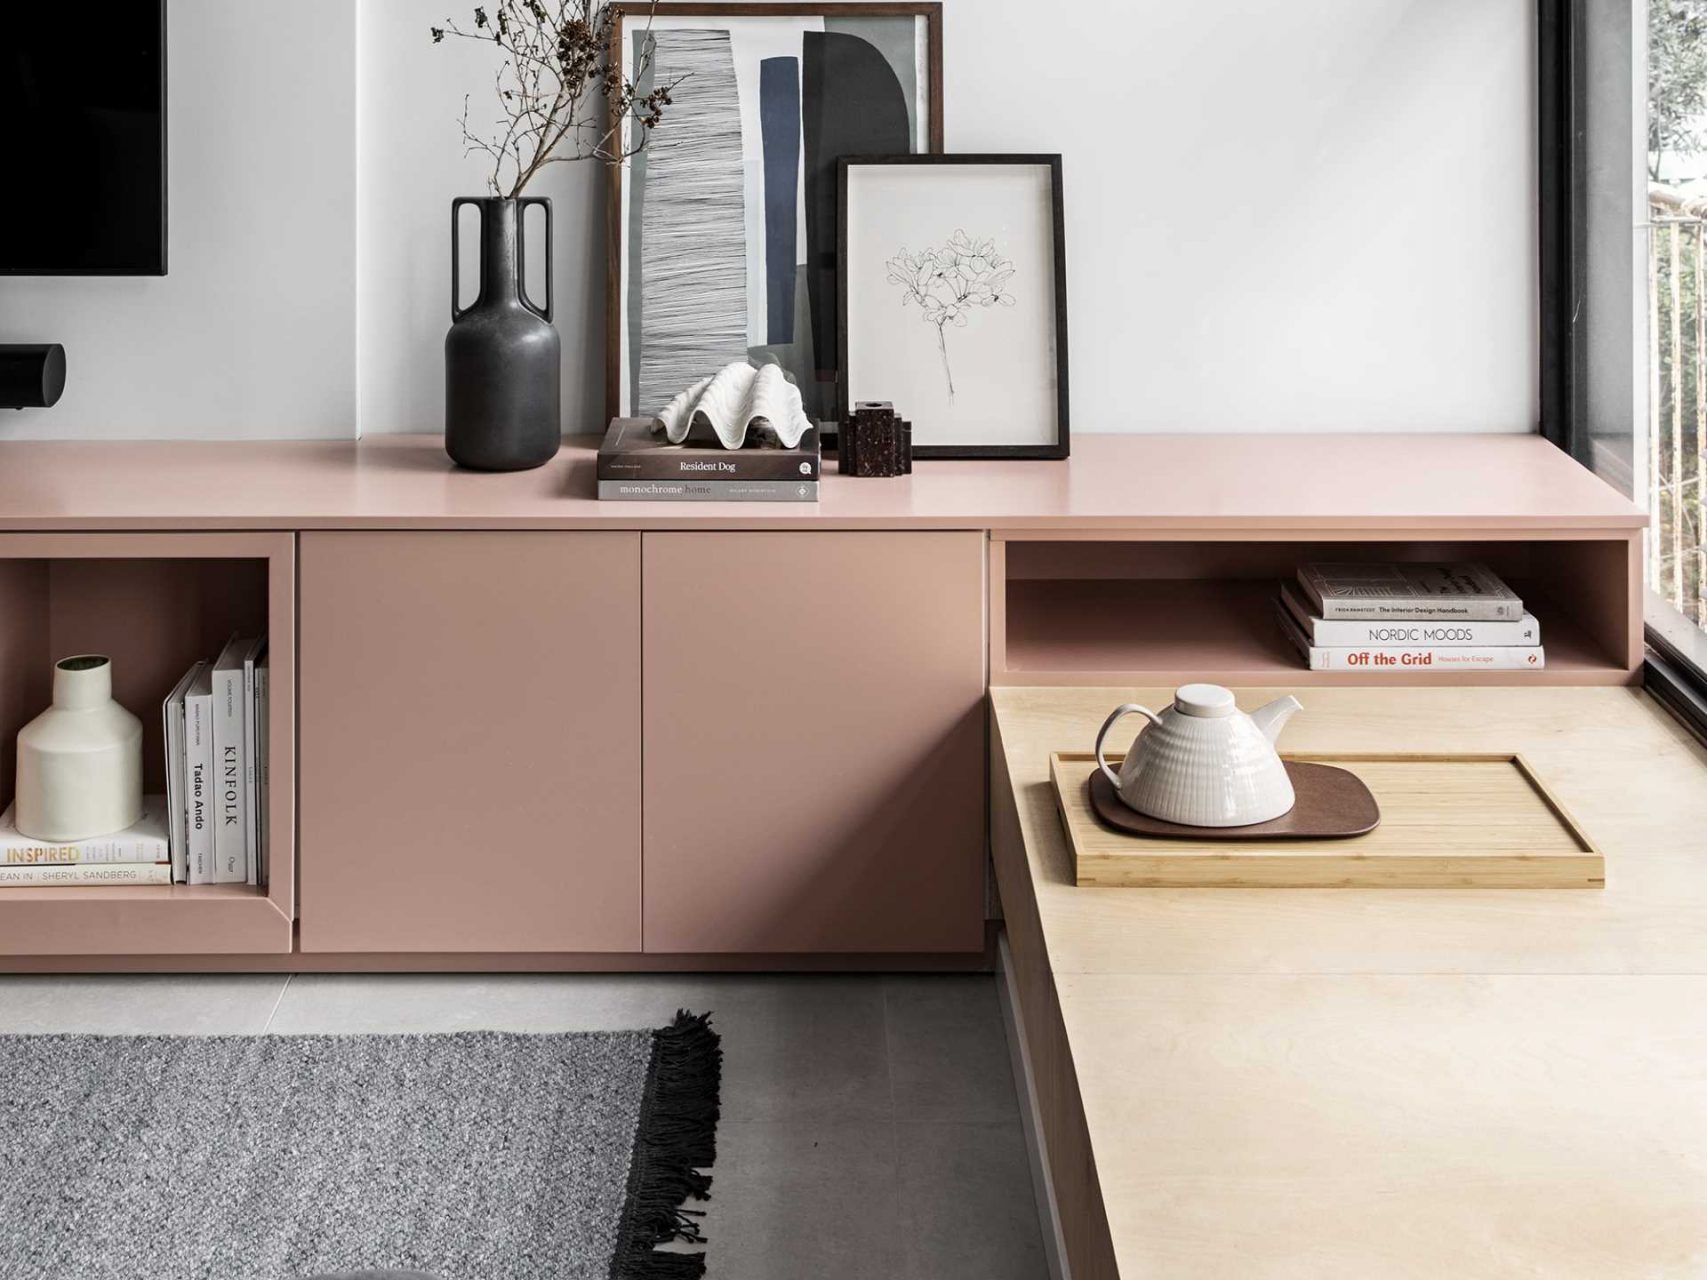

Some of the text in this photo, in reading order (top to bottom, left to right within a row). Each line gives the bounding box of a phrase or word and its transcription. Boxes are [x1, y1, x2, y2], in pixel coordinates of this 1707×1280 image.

[680, 461, 736, 473] Resident Dog
[620, 483, 711, 494] monochrome home
[1392, 606, 1413, 614] Interior
[1414, 606, 1436, 615] Design
[1437, 606, 1468, 615] Handbook
[1369, 628, 1473, 641] NORDIC MOODS
[1347, 652, 1432, 665] Off the Grid
[225, 745, 238, 825] KINFOLK
[194, 763, 203, 830] Tadao Ando
[6, 846, 81, 863] INSPIRED
[0, 872, 33, 881] EAN IN
[42, 870, 137, 880] SHERYL SANDBERG
